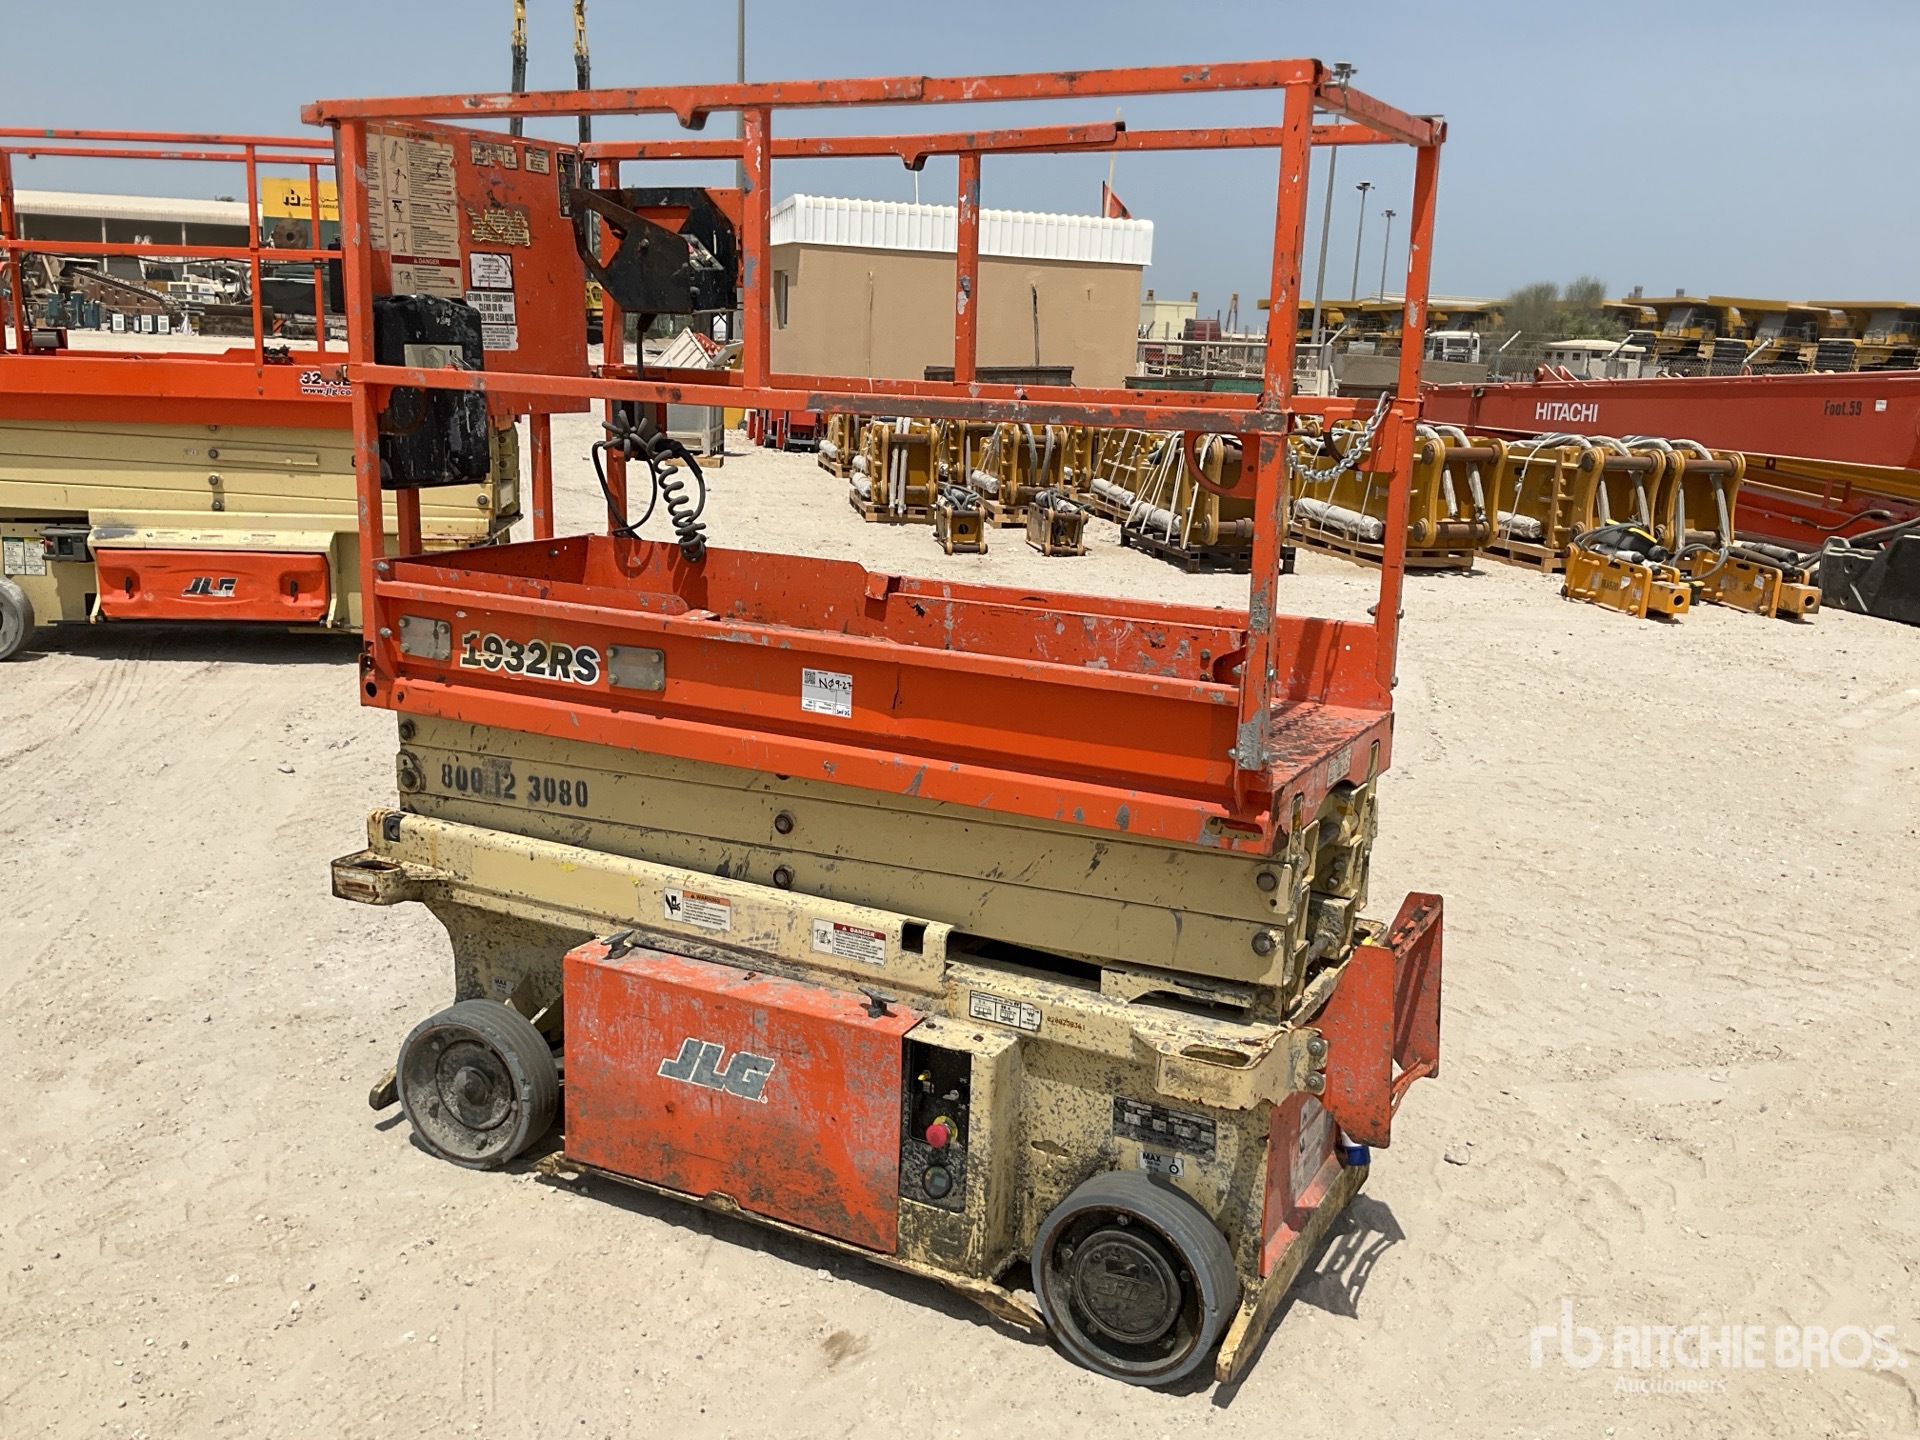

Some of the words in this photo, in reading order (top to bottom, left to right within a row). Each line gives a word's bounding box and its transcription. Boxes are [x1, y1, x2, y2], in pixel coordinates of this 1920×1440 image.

[498, 304, 503, 312] BE
[495, 313, 514, 321] CLEANING
[1535, 402, 1598, 422] HITACHI
[461, 631, 600, 685] 1932RS
[441, 763, 484, 793] 800
[528, 775, 588, 808] 3080
[696, 894, 721, 904] WARNING
[850, 927, 875, 938] DANGER
[657, 1037, 775, 1103] JLG
[1142, 1152, 1162, 1163] MAX
